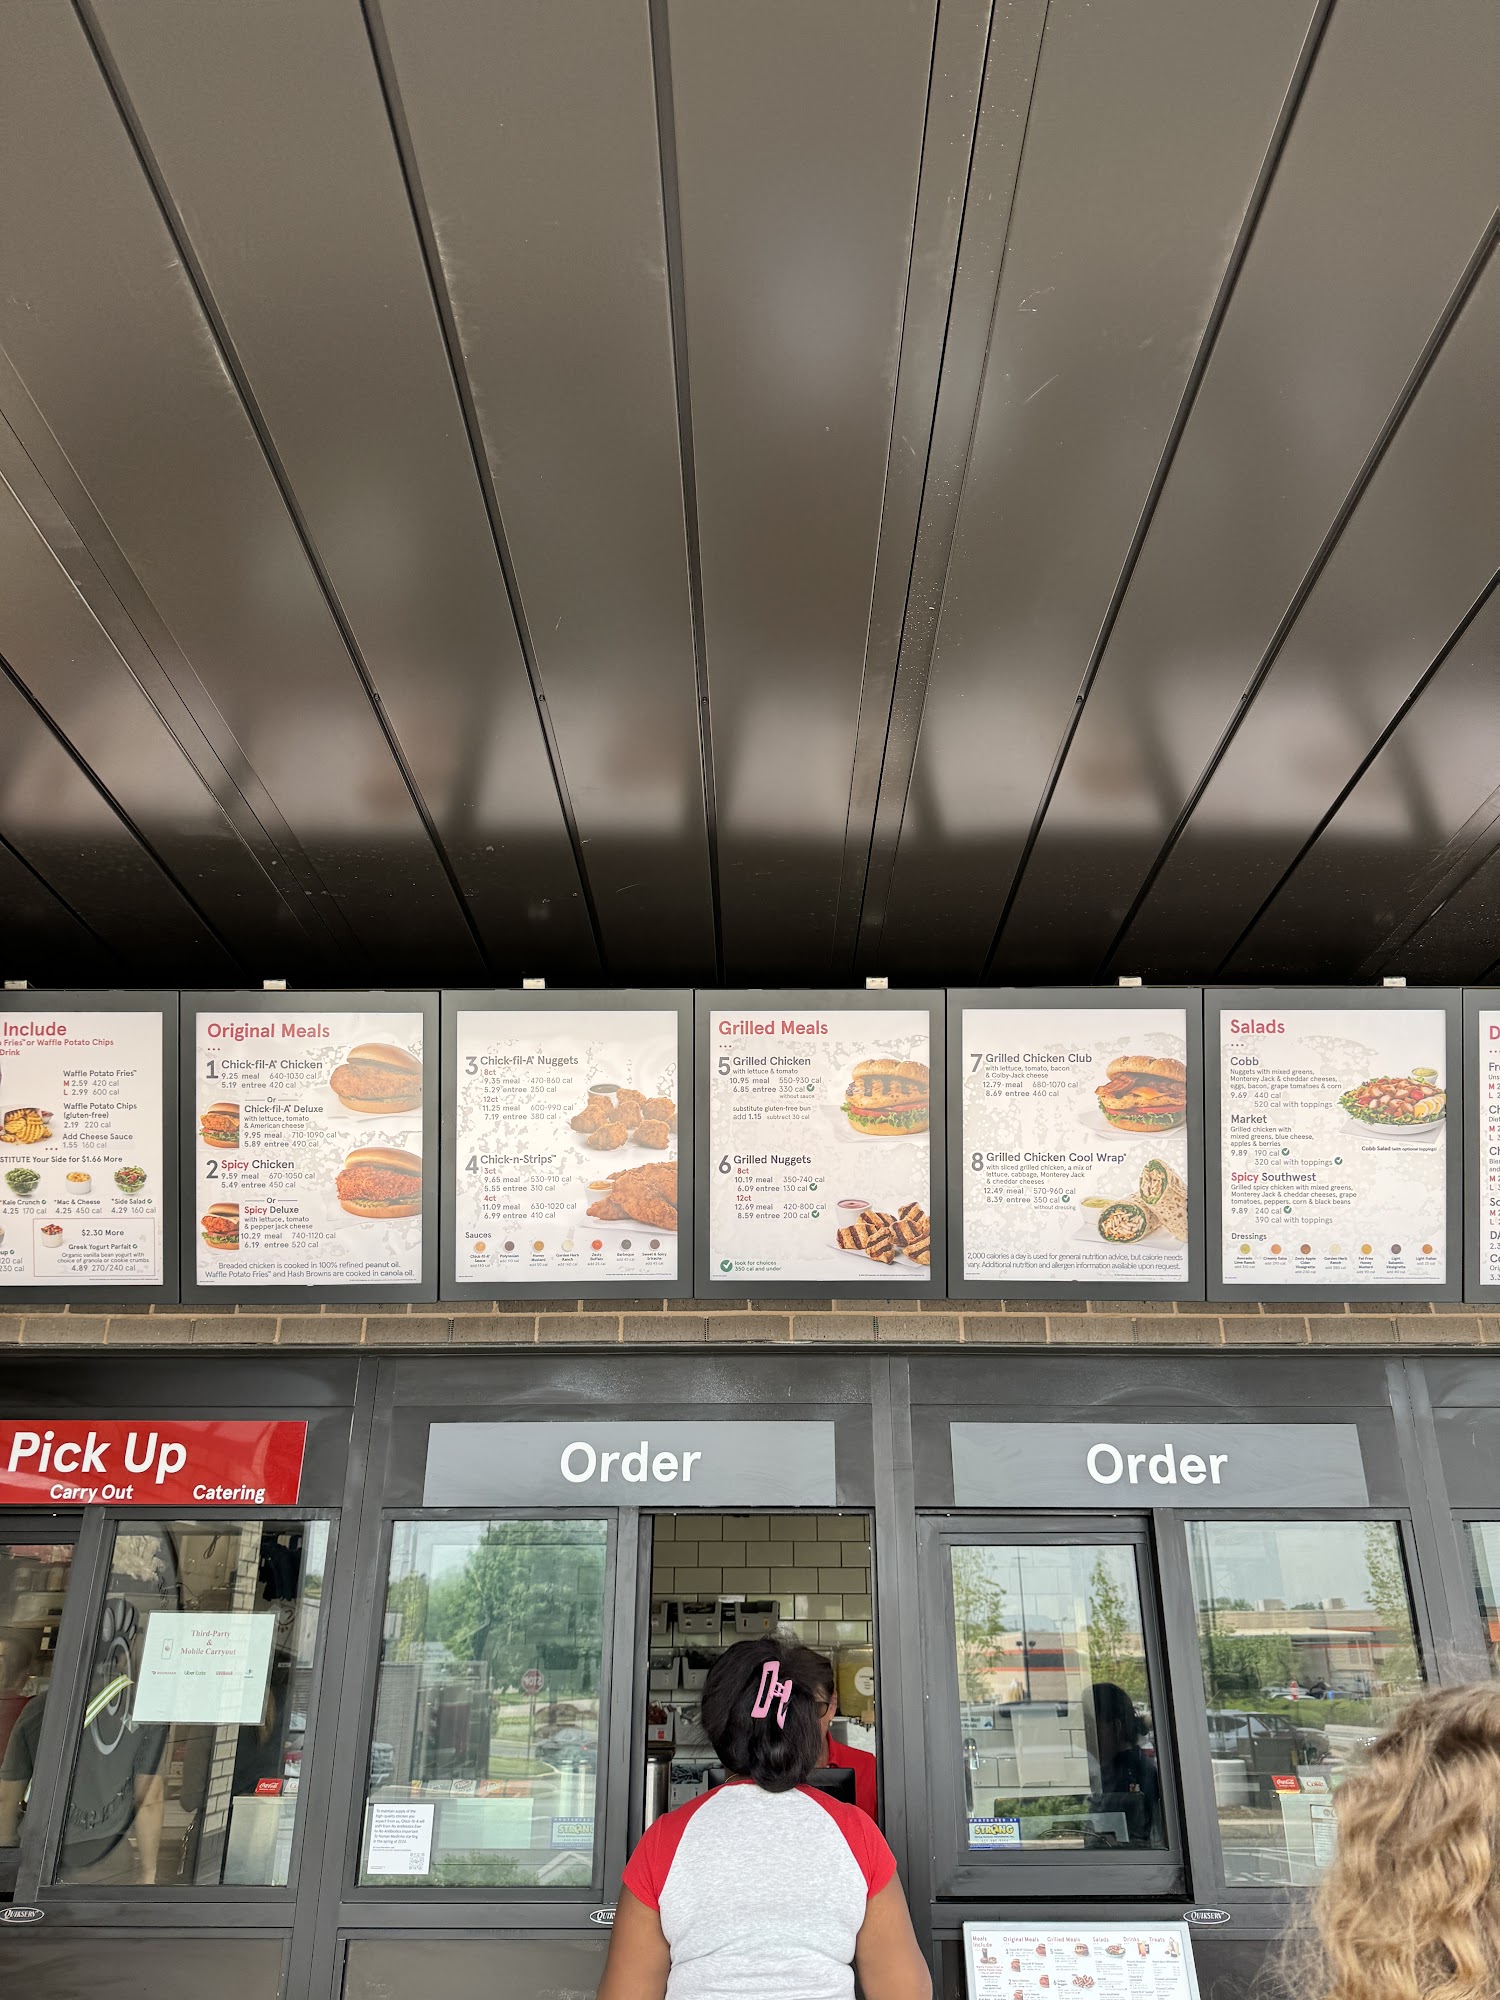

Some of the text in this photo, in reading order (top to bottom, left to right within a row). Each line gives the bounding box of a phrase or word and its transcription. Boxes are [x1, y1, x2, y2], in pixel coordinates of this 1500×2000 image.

[3, 1022, 67, 1036] Include
[208, 1023, 330, 1041] Original Meals
[719, 1021, 828, 1035] Grilled Meals
[1231, 1019, 1285, 1034] Salads
[206, 1060, 218, 1078] 1
[281, 1060, 322, 1069] Chicken
[465, 1057, 478, 1075] 3
[538, 1056, 578, 1067] Nuggets
[718, 1057, 810, 1075] 5 Grilled Chicken
[971, 1054, 1092, 1072] 7 Grilled Chicken Club
[1231, 1057, 1259, 1065] Cobb
[117, 1103, 137, 1111] Chips
[294, 1105, 323, 1113] Deluxe
[1301, 1101, 1332, 1109] toppings
[1231, 1115, 1267, 1123] Market
[206, 1160, 294, 1178] 2 Spicy Chicken
[465, 1156, 479, 1174] 4
[719, 1155, 811, 1174] 6 Grilled Nuggets
[972, 1153, 984, 1171] 8
[986, 1153, 1020, 1162] Grilled
[1024, 1153, 1066, 1162] Chicken
[1069, 1153, 1093, 1162] Cool
[1232, 1172, 1316, 1183] Spicy Southwest
[244, 1207, 267, 1216] Spicy
[7, 1431, 187, 1484] Pick Up
[560, 1441, 701, 1482] Order
[1086, 1444, 1228, 1484] Order
[50, 1484, 265, 1503] Carry Out Catering
[205, 1648, 236, 1656] Carryout
[975, 1824, 1014, 1834] STRONG
